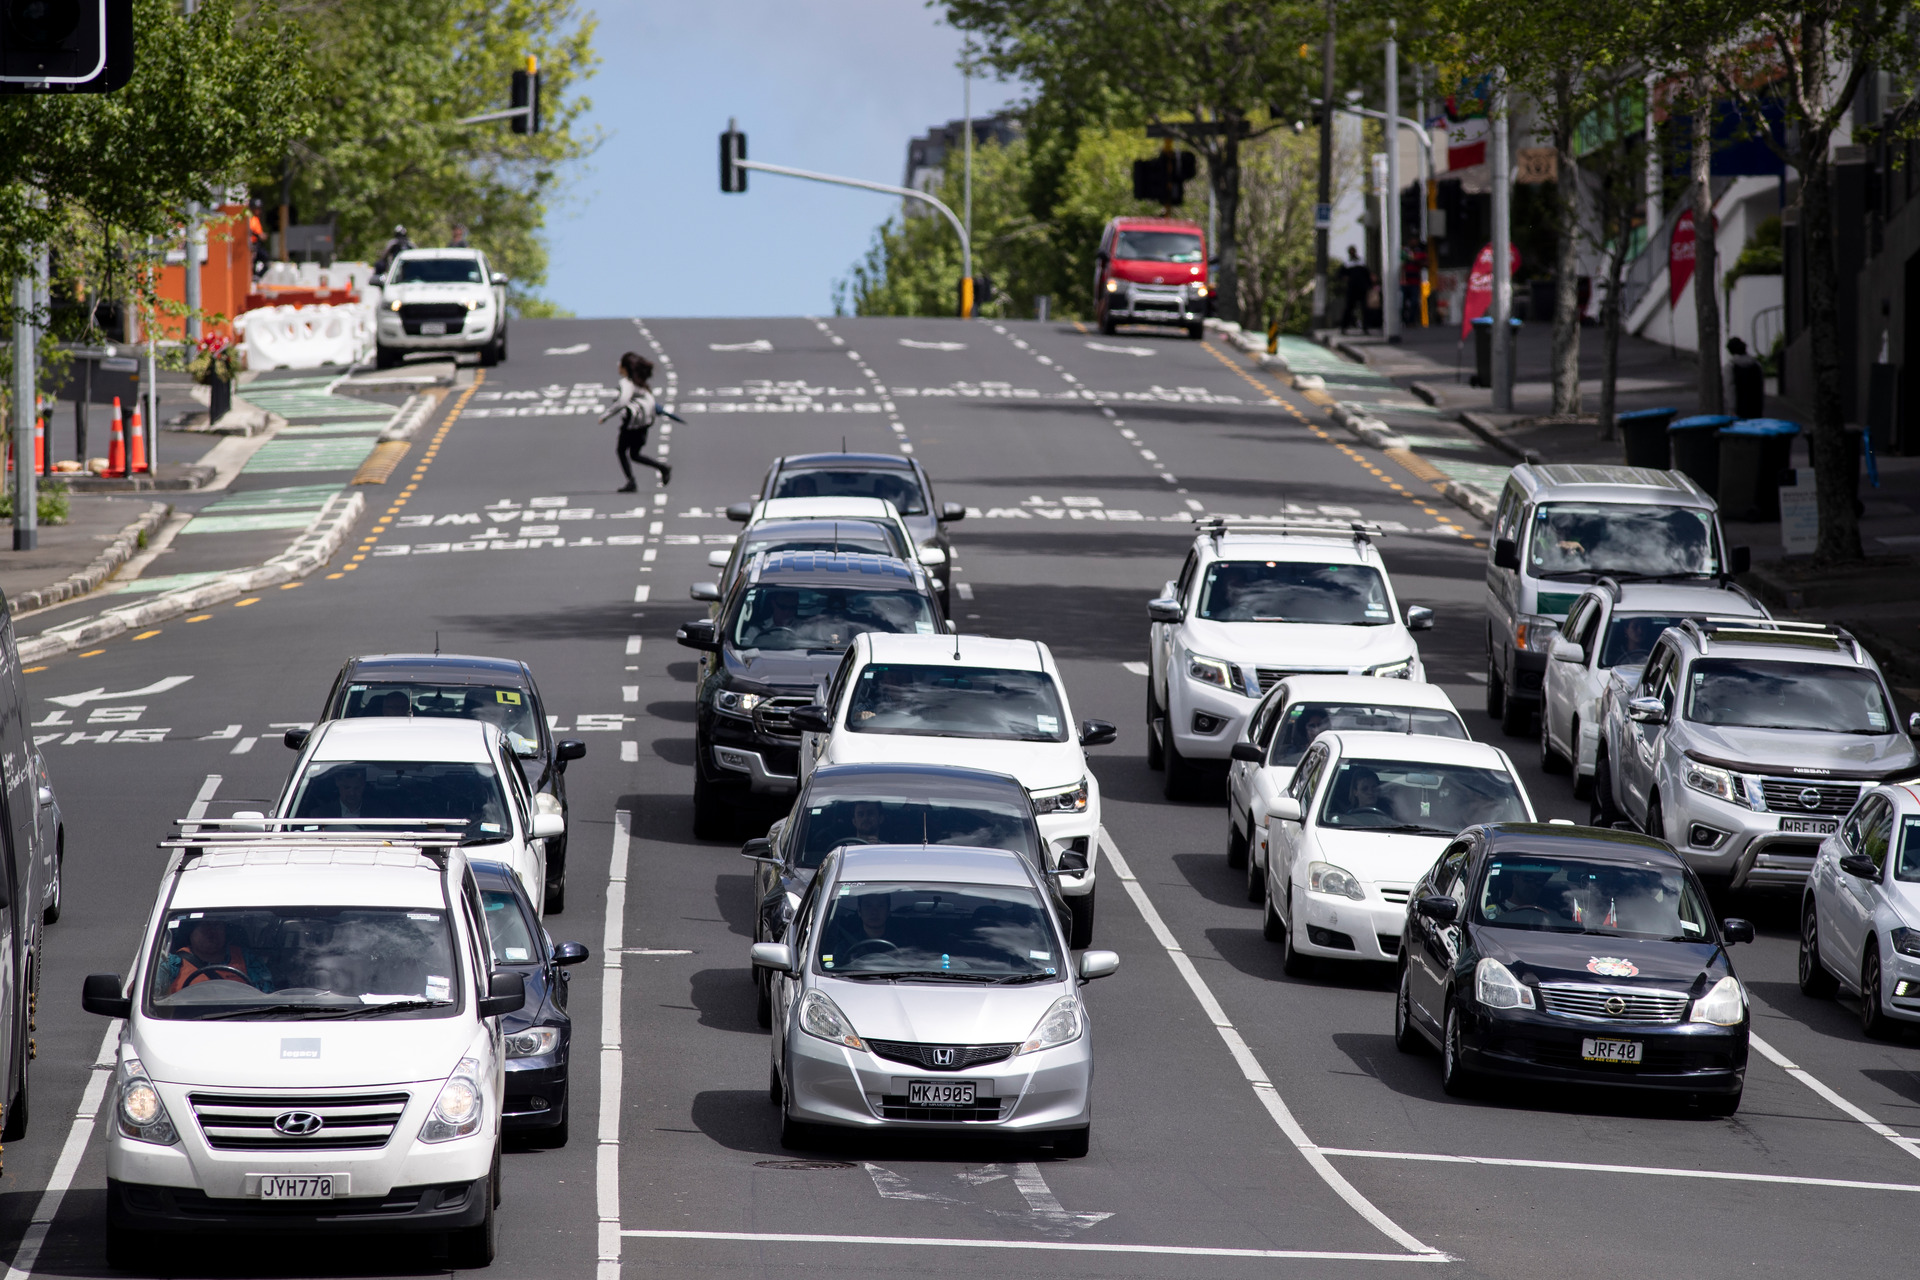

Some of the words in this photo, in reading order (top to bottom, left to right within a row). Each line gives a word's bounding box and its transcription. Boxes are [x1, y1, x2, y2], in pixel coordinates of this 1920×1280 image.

[460, 404, 605, 419] URDEE
[484, 496, 568, 510] ST
[1021, 495, 1103, 507] ST
[470, 524, 560, 539] ST
[372, 535, 645, 556] STURDEE
[502, 693, 515, 702] L
[31, 705, 147, 727] ST
[283, 1050, 318, 1058] legacy
[1588, 1041, 1636, 1059] JRF40
[912, 1085, 973, 1102] MKA905
[264, 1179, 331, 1196] JYH770
